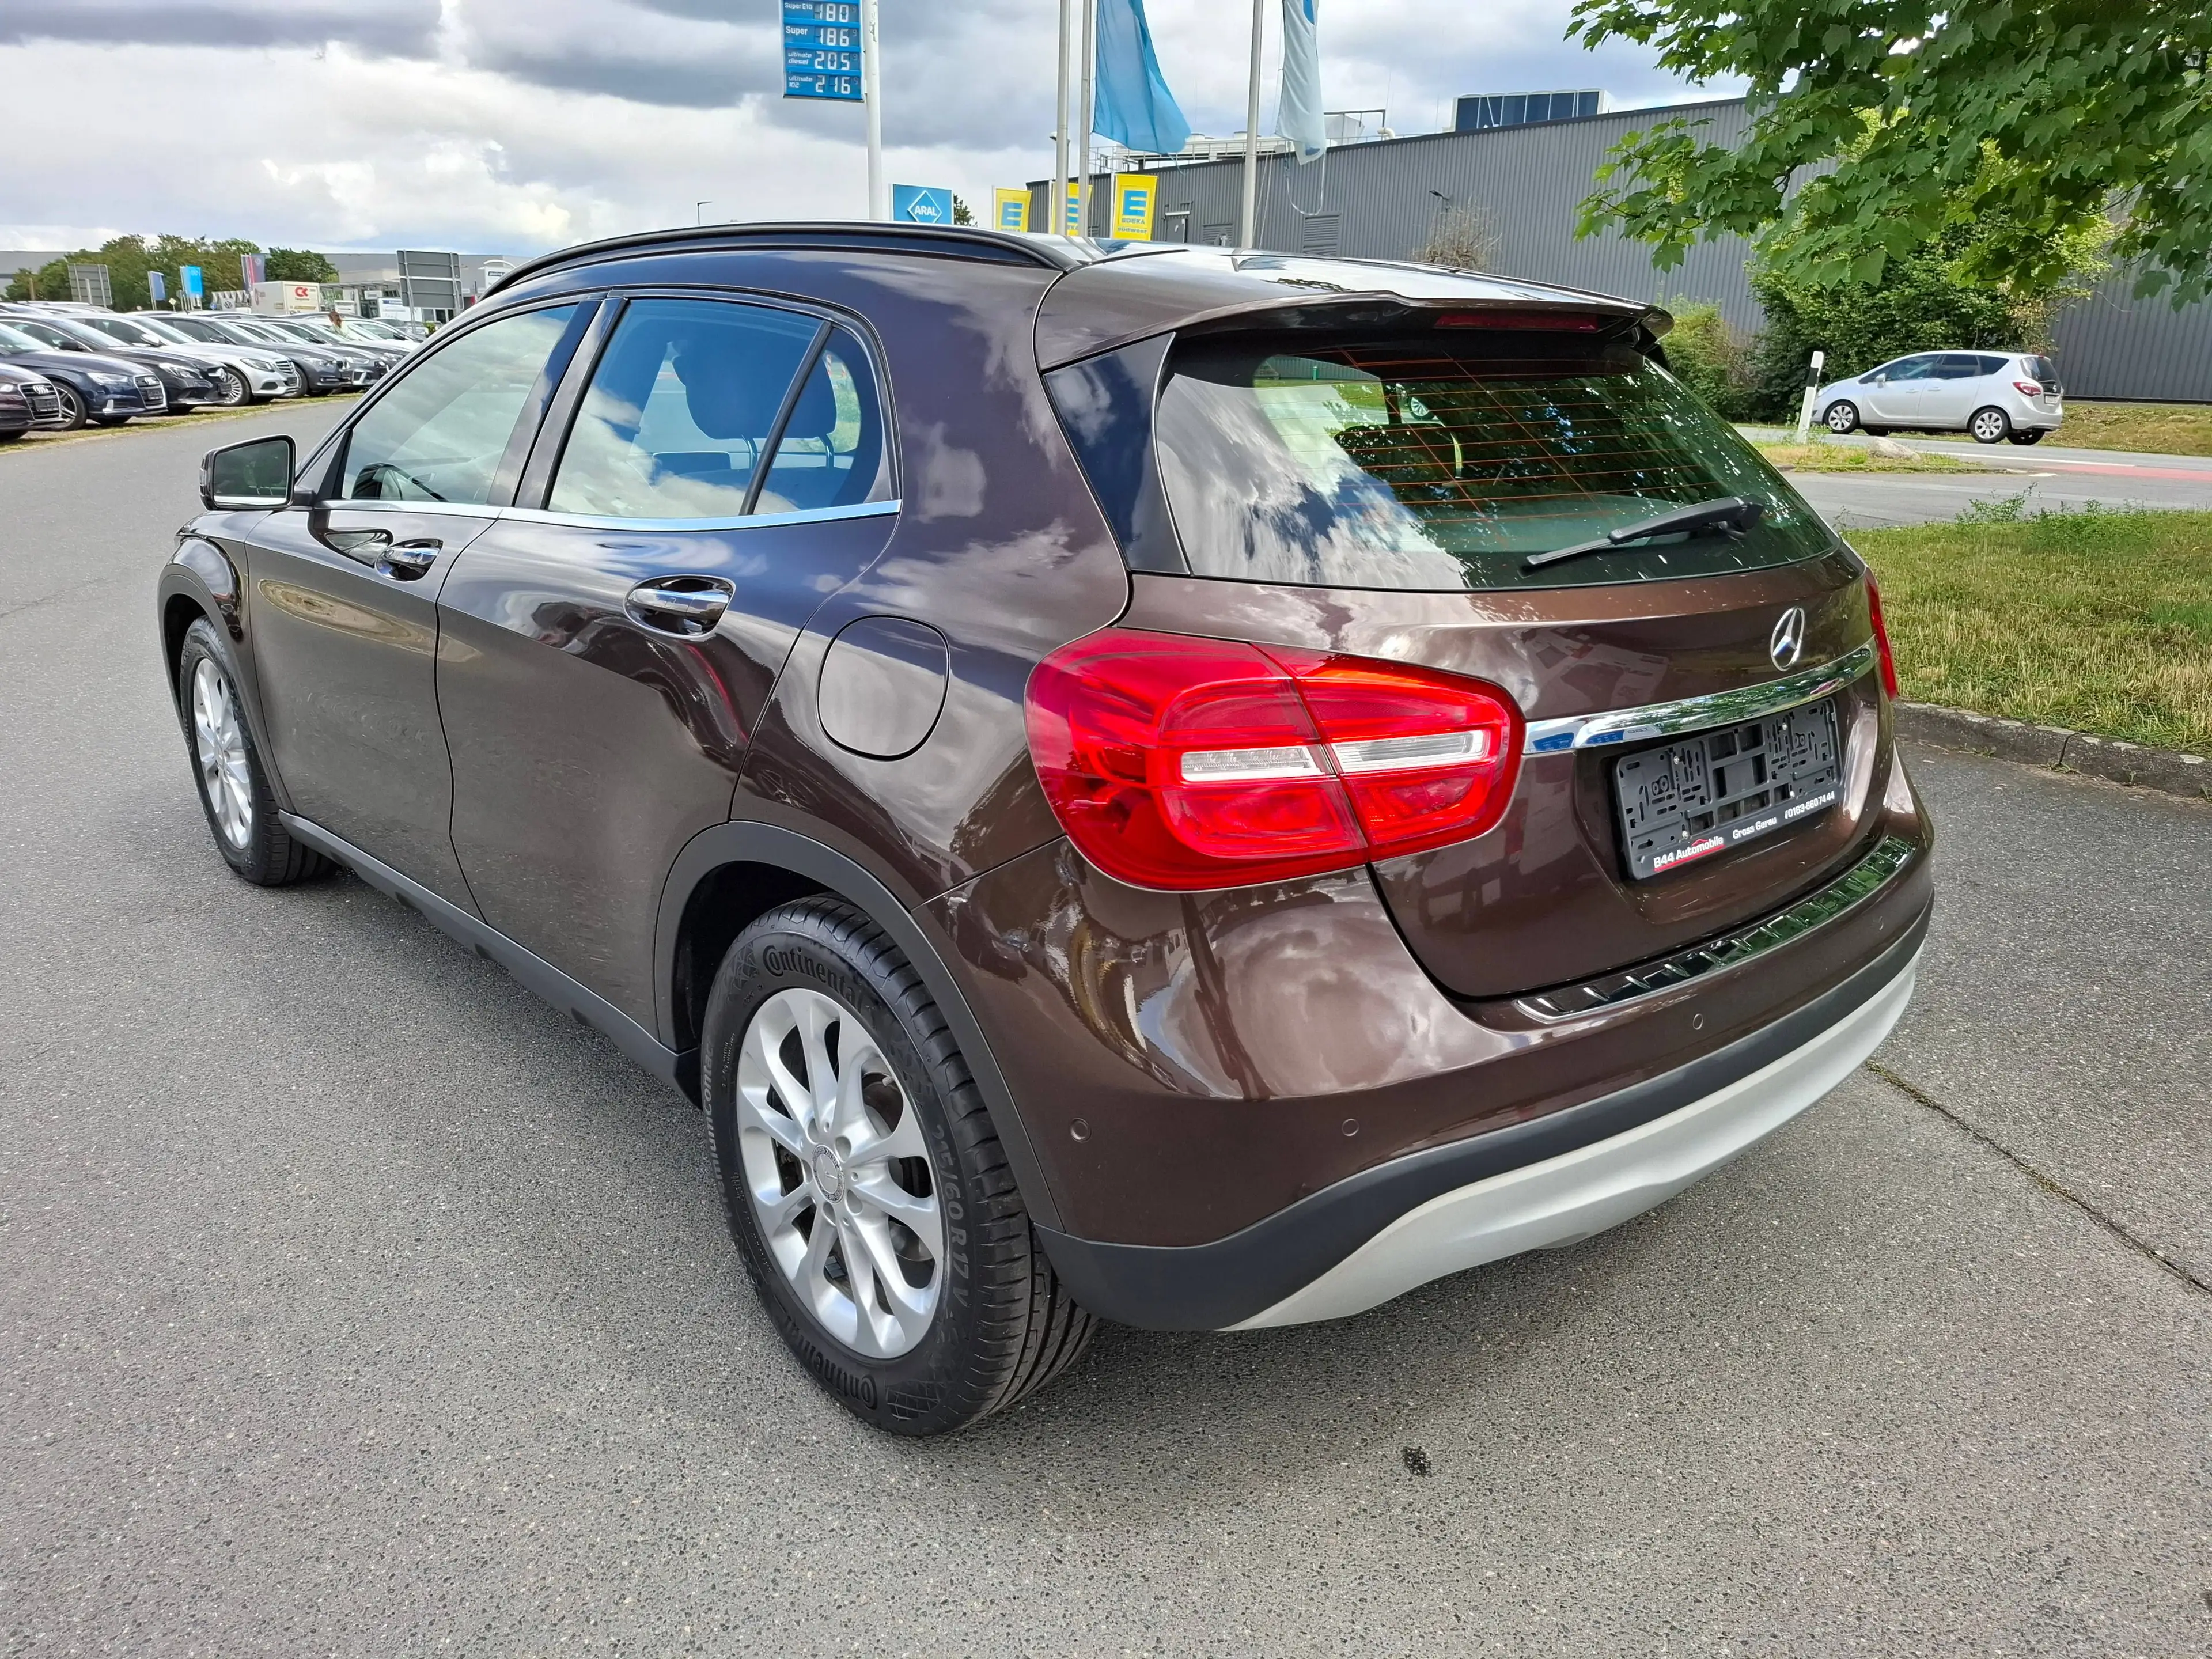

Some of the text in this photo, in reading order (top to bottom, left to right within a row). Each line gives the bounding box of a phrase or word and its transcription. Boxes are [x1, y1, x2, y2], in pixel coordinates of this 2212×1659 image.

[820, 3, 849, 22] 180
[786, 26, 808, 36] Super
[820, 28, 849, 46] 186
[815, 51, 850, 70] 205
[816, 75, 850, 94] 216
[914, 205, 938, 217] ARAL
[1653, 852, 1675, 868] B44
[1732, 825, 1755, 839] Gross
[1755, 817, 1777, 831] Gerau
[763, 945, 865, 1013] Continental
